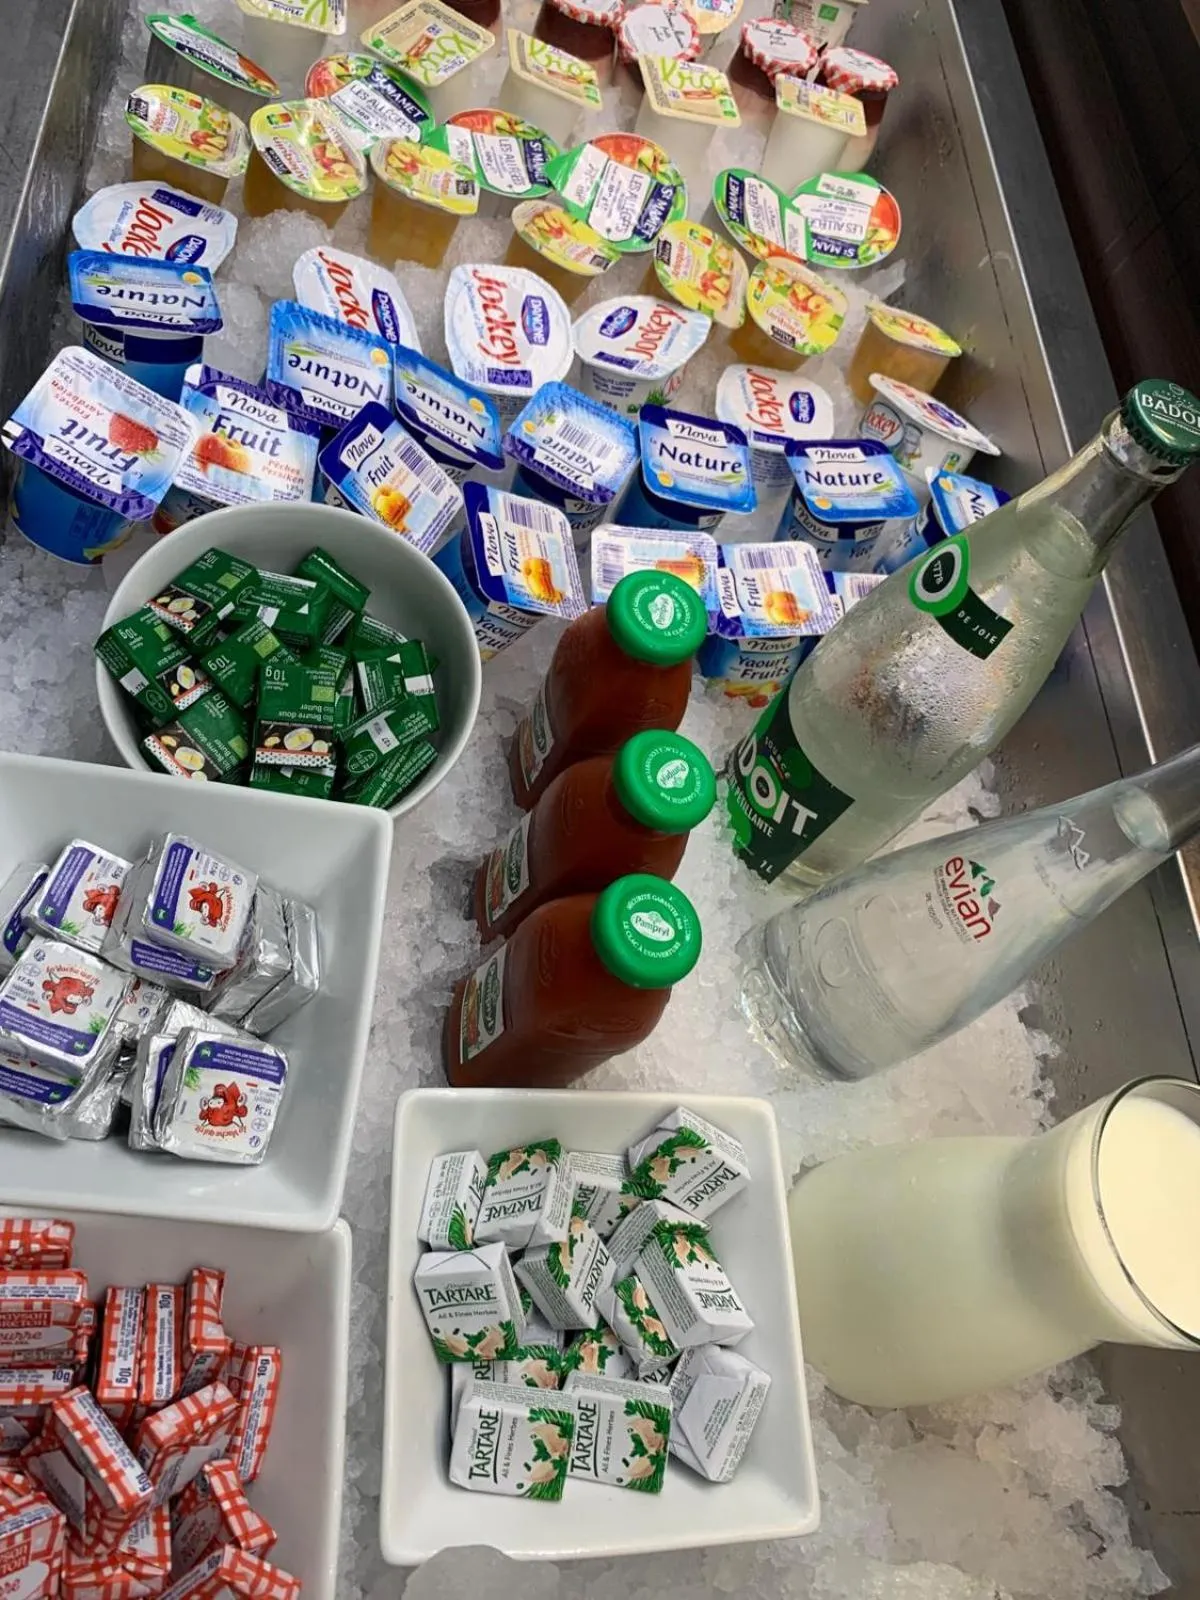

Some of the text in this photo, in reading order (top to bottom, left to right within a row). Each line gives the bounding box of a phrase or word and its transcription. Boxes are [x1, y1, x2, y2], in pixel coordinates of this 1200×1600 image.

[350, 84, 369, 100] LES
[385, 83, 425, 118] MAMET
[96, 285, 206, 309] Nature
[471, 268, 523, 366] Jockey
[530, 298, 546, 345] DANONE
[625, 303, 687, 361] Jockey
[86, 325, 124, 358] Nova
[286, 352, 384, 401] Nature
[53, 391, 92, 420] Fraises
[226, 393, 280, 424] Nova
[406, 382, 486, 439] Nature
[745, 367, 785, 433] Jockey
[59, 418, 138, 471] Fruit
[211, 414, 283, 457] Fruit
[346, 431, 377, 464] Nova
[675, 423, 721, 443] Nova
[53, 446, 111, 486] Nova
[367, 453, 396, 488] Fruit
[541, 435, 602, 475] Nature
[543, 455, 586, 487] Nova
[658, 441, 742, 474] Nature
[814, 448, 857, 461] Nova
[804, 468, 886, 487] Nature
[966, 487, 987, 519] Na
[797, 505, 830, 538] Nova
[486, 522, 500, 568] Nova
[504, 531, 522, 573] Fruit
[933, 559, 944, 585] 1778
[719, 574, 734, 612] Nova
[741, 575, 763, 610] Fruit
[957, 610, 998, 645] DE JOIE
[747, 639, 793, 651] Nova
[738, 655, 790, 670] Yaourt
[740, 666, 790, 681] Fruits
[945, 855, 992, 940] evian
[635, 915, 671, 938] Pampryl
[682, 1166, 741, 1212] TARTARE
[484, 1195, 542, 1222] TARTARE
[423, 1283, 498, 1306] TARTARE
[581, 1247, 610, 1313] TARTARE
[160, 1294, 173, 1310] 10g
[455, 1310, 472, 1318] Fines
[474, 1309, 498, 1317] Herbes
[695, 1292, 743, 1312] TARTARE
[115, 1366, 132, 1385] 10g
[257, 1357, 271, 1377] 10g
[468, 1407, 500, 1481] TARTARE
[509, 1416, 519, 1441] Herbes
[569, 1400, 598, 1473] TARTARE
[601, 1459, 609, 1473] Ail
[608, 1410, 616, 1436] Herbes
[505, 1442, 514, 1460] Fines
[501, 1464, 509, 1478] Ail
